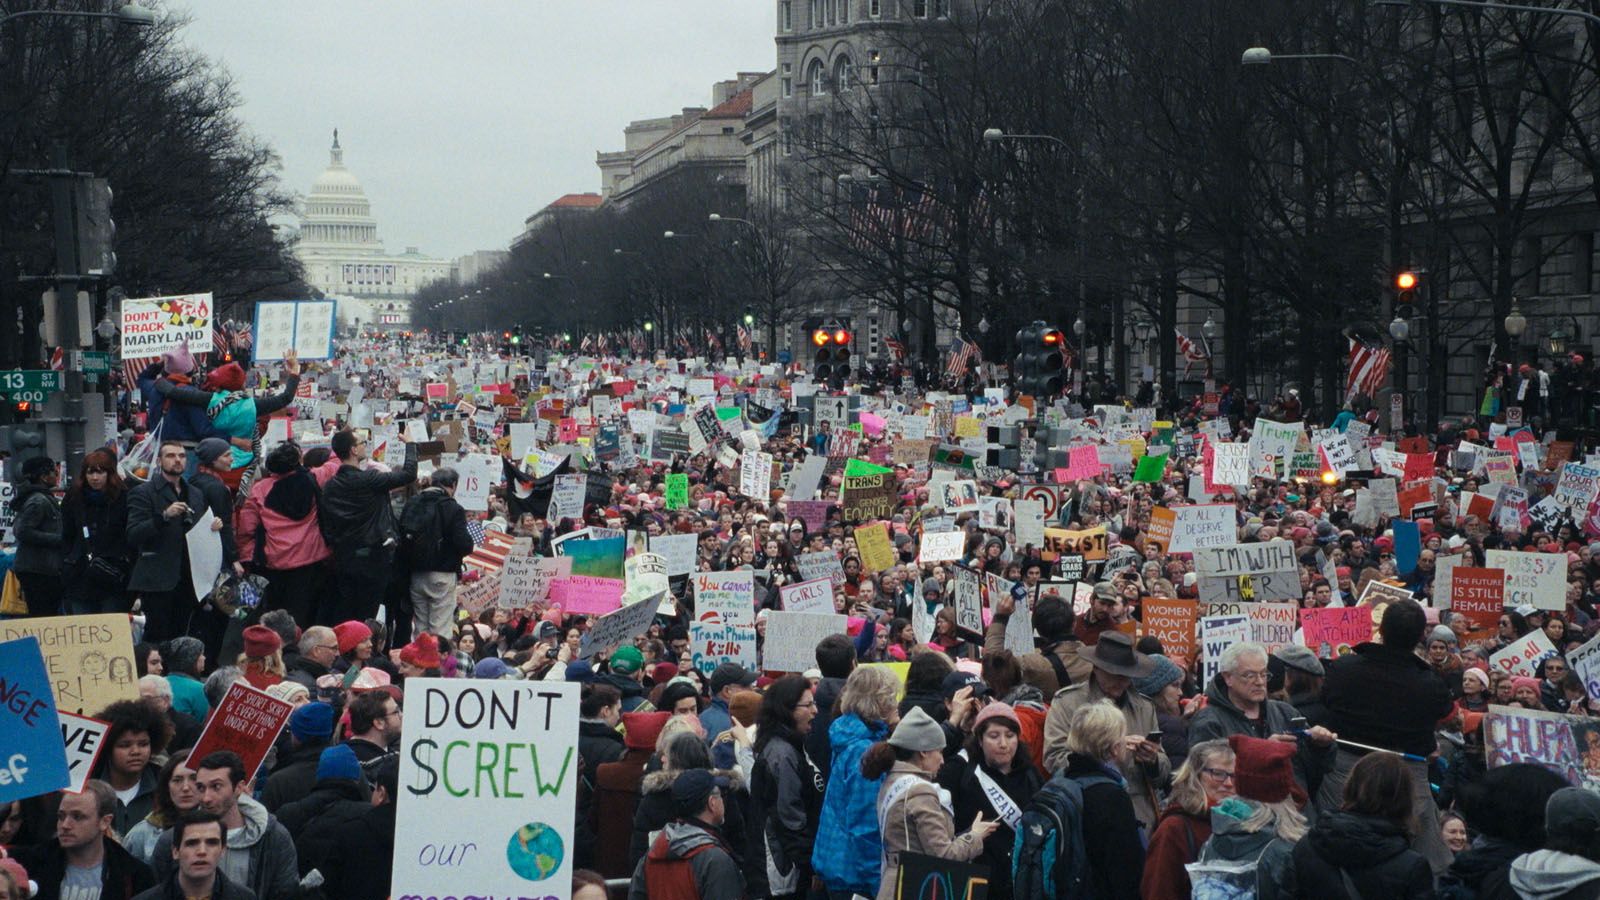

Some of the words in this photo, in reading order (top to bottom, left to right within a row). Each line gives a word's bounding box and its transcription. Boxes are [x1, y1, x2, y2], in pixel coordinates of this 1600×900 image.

[124, 311, 159, 322] DON'T
[124, 322, 165, 333] FRACK
[124, 330, 204, 346] MARYLAND
[3, 373, 24, 388] 13
[12, 391, 43, 401] 400
[1325, 442, 1335, 451] WE
[1337, 439, 1347, 447] ARE
[1332, 449, 1345, 458] NOT
[1217, 457, 1227, 469] IS
[1231, 458, 1248, 470] NOT
[1564, 463, 1599, 477] KEEP
[466, 477, 478, 491] IS
[848, 476, 881, 487] TRANS
[1564, 473, 1593, 485] YOUR
[1555, 493, 1586, 510] OUR
[844, 505, 896, 520] EQUALITY
[1198, 510, 1210, 520] ALL
[1150, 525, 1172, 534] NOISY
[1186, 522, 1223, 535] DESERVE
[927, 536, 951, 546] YES
[1042, 534, 1104, 552] RESIST
[923, 550, 934, 559] WE
[1246, 545, 1294, 571] WITH
[570, 576, 591, 586] Nasty
[699, 576, 719, 591] You
[721, 581, 752, 592] cannot
[1471, 578, 1502, 586] FUTURE
[1505, 575, 1538, 588] RABS
[789, 585, 824, 604] GIRLS
[1454, 587, 1464, 597] IS
[1468, 588, 1500, 599] STILL
[1505, 591, 1533, 604] ACK!
[1147, 606, 1192, 616] WOMEN
[1453, 601, 1500, 612] FEMALE
[722, 611, 738, 622] you
[1340, 608, 1368, 624] ARE
[1147, 618, 1191, 628] WON'T
[1148, 630, 1189, 642] BACK
[1250, 625, 1293, 643] HILDREN
[1498, 655, 1520, 670] Do
[1524, 640, 1541, 659] all
[230, 687, 245, 700] MY
[244, 692, 268, 709] SHORT
[267, 701, 287, 718] SKIRT
[425, 688, 562, 730] DON'T
[226, 701, 235, 711] &
[234, 703, 278, 729] EVERYTHING
[224, 714, 248, 732] UNDER
[248, 723, 258, 735] IT
[256, 728, 267, 739] IS
[1485, 714, 1579, 762] CHUPA
[987, 786, 1016, 819] HEAR
[419, 842, 477, 866] our
